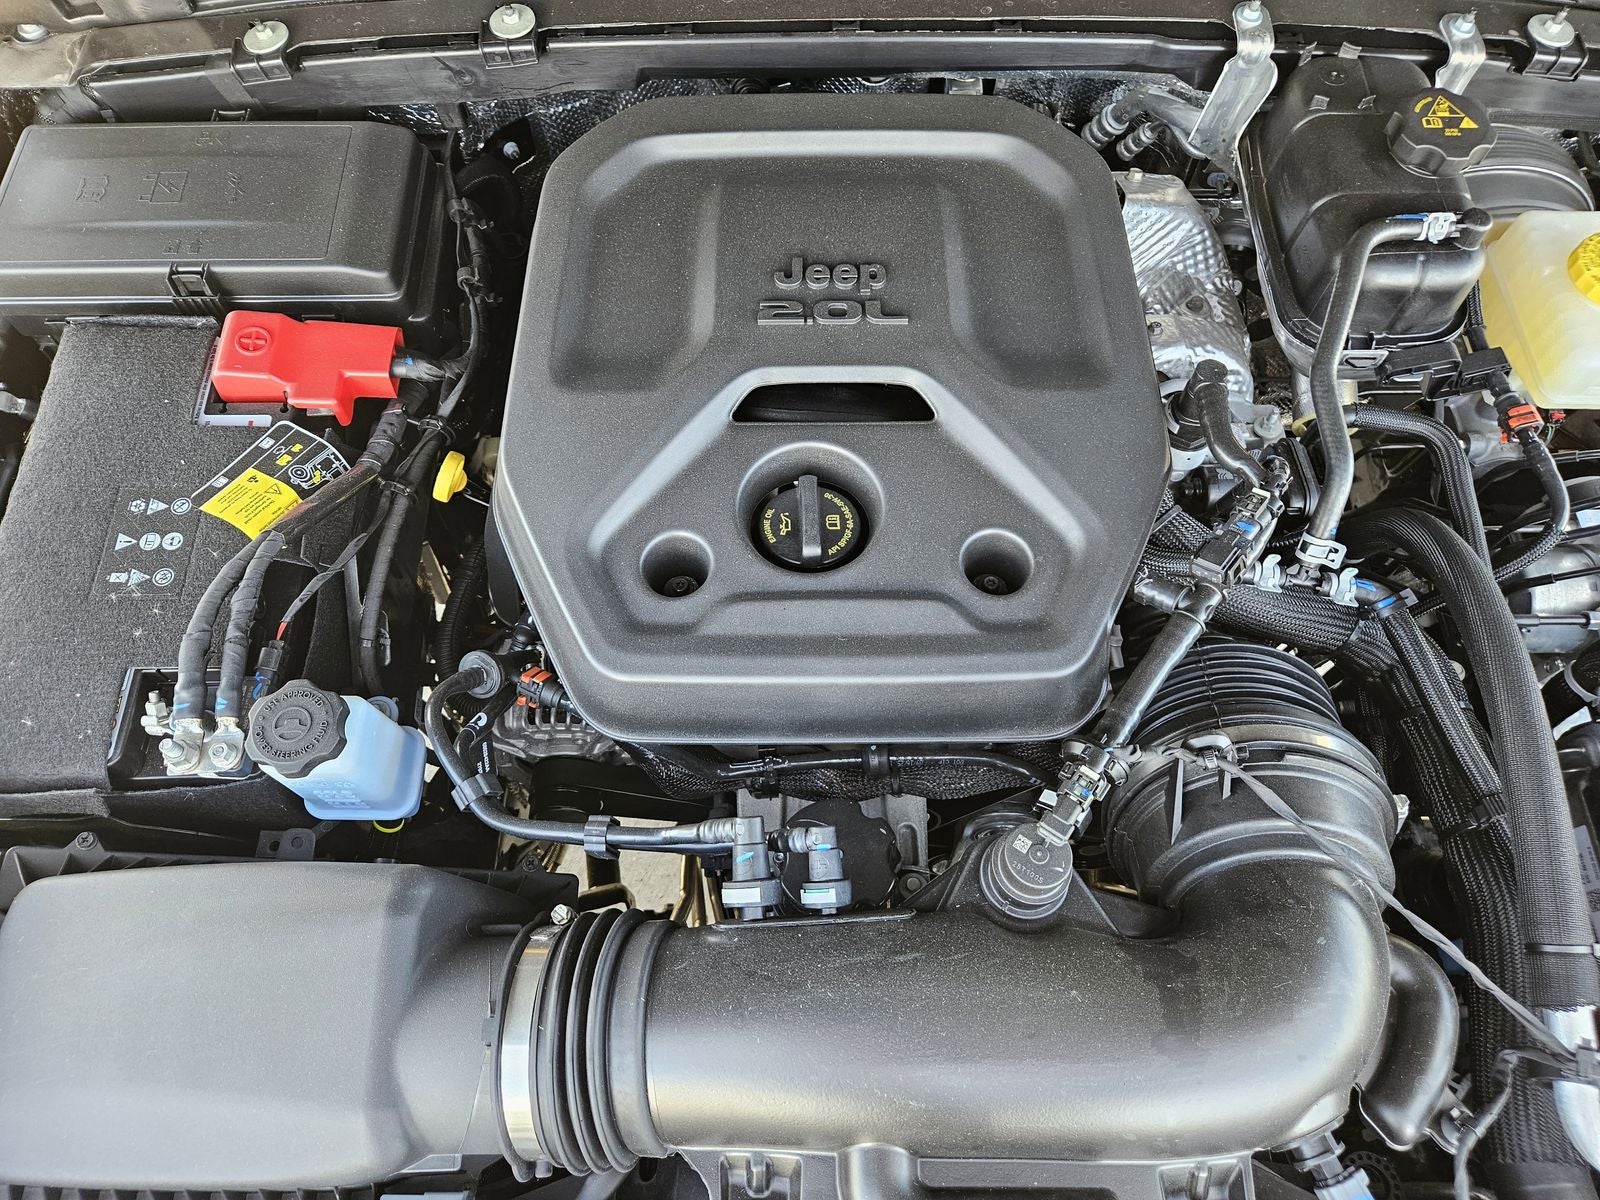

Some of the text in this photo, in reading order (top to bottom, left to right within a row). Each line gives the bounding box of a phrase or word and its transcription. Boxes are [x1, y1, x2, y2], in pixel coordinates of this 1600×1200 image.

[773, 256, 887, 296] Jeep
[757, 299, 909, 326] 2.0L
[763, 508, 776, 544] ENGINE OIL
[827, 545, 841, 556] API
[263, 690, 325, 713] USE APPROVED
[256, 720, 329, 759] POWER STEERING FLUID
